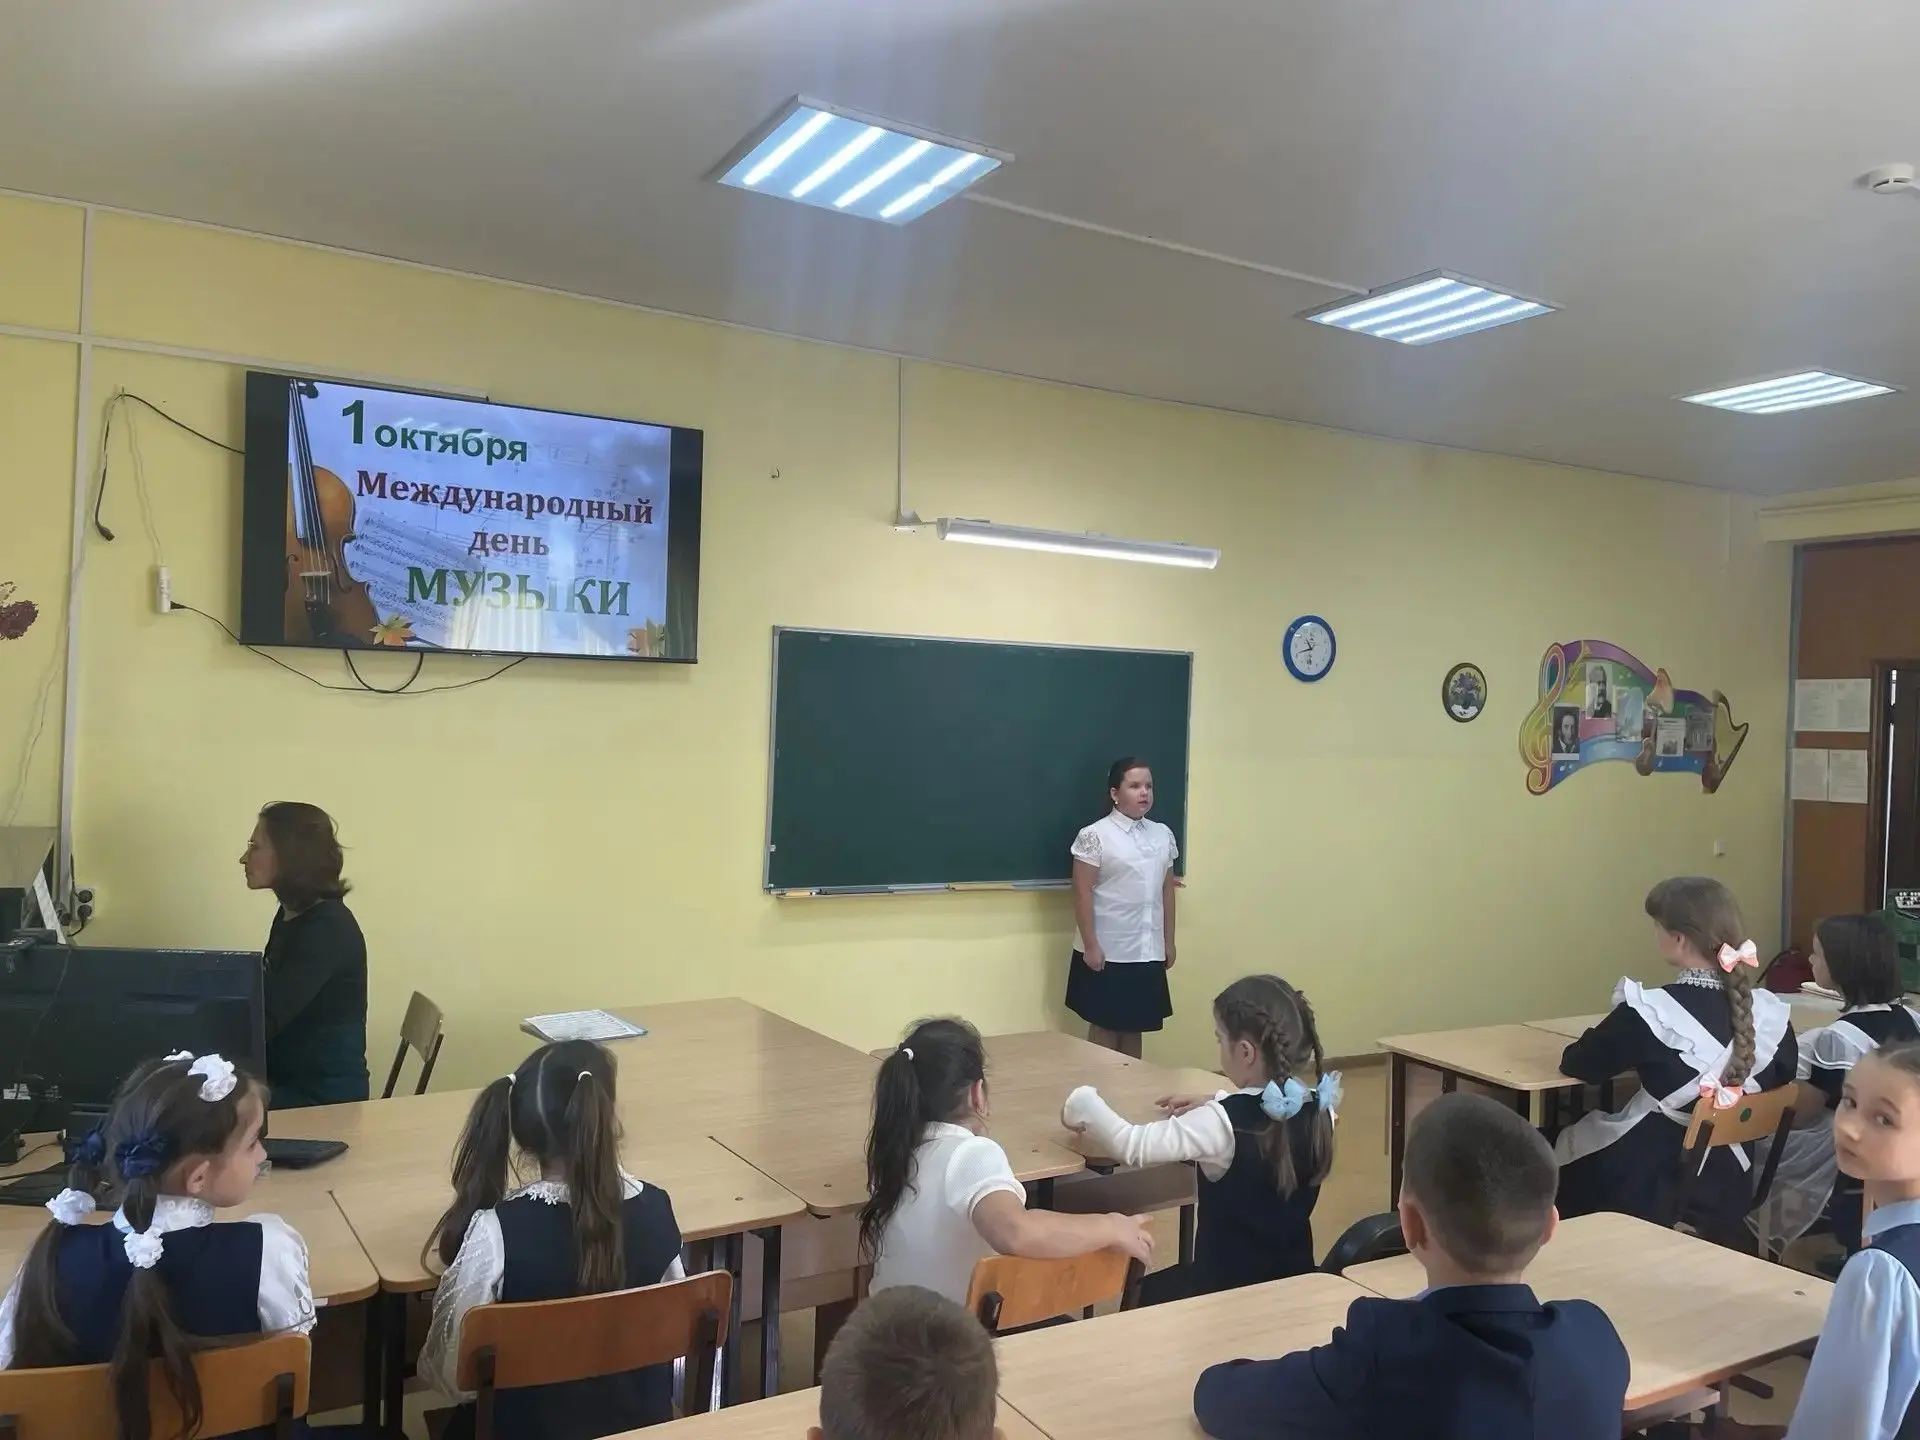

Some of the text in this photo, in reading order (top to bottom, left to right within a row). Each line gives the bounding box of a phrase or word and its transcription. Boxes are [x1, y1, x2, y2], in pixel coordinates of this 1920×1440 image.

[341, 400, 528, 465] 1 октября
[356, 470, 654, 525] Международный
[467, 531, 551, 557] день
[407, 566, 631, 616] МУЗЫКИ
